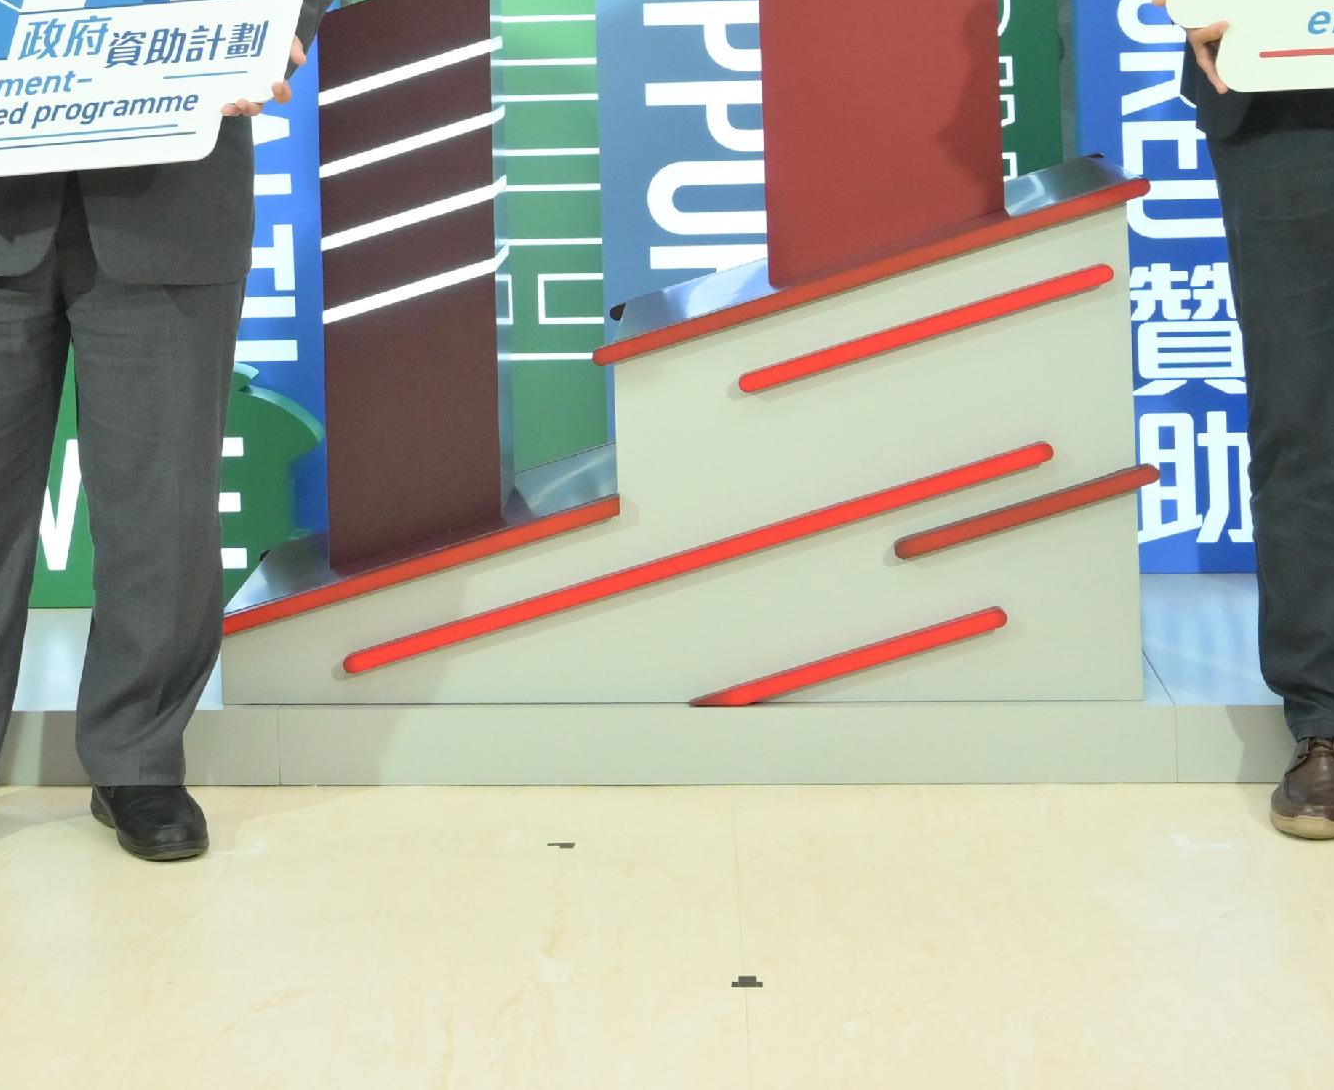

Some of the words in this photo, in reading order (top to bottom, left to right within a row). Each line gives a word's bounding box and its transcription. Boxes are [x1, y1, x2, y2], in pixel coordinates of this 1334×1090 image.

[18, 15, 270, 68] 政府資助計劃
[32, 94, 199, 129] programme
